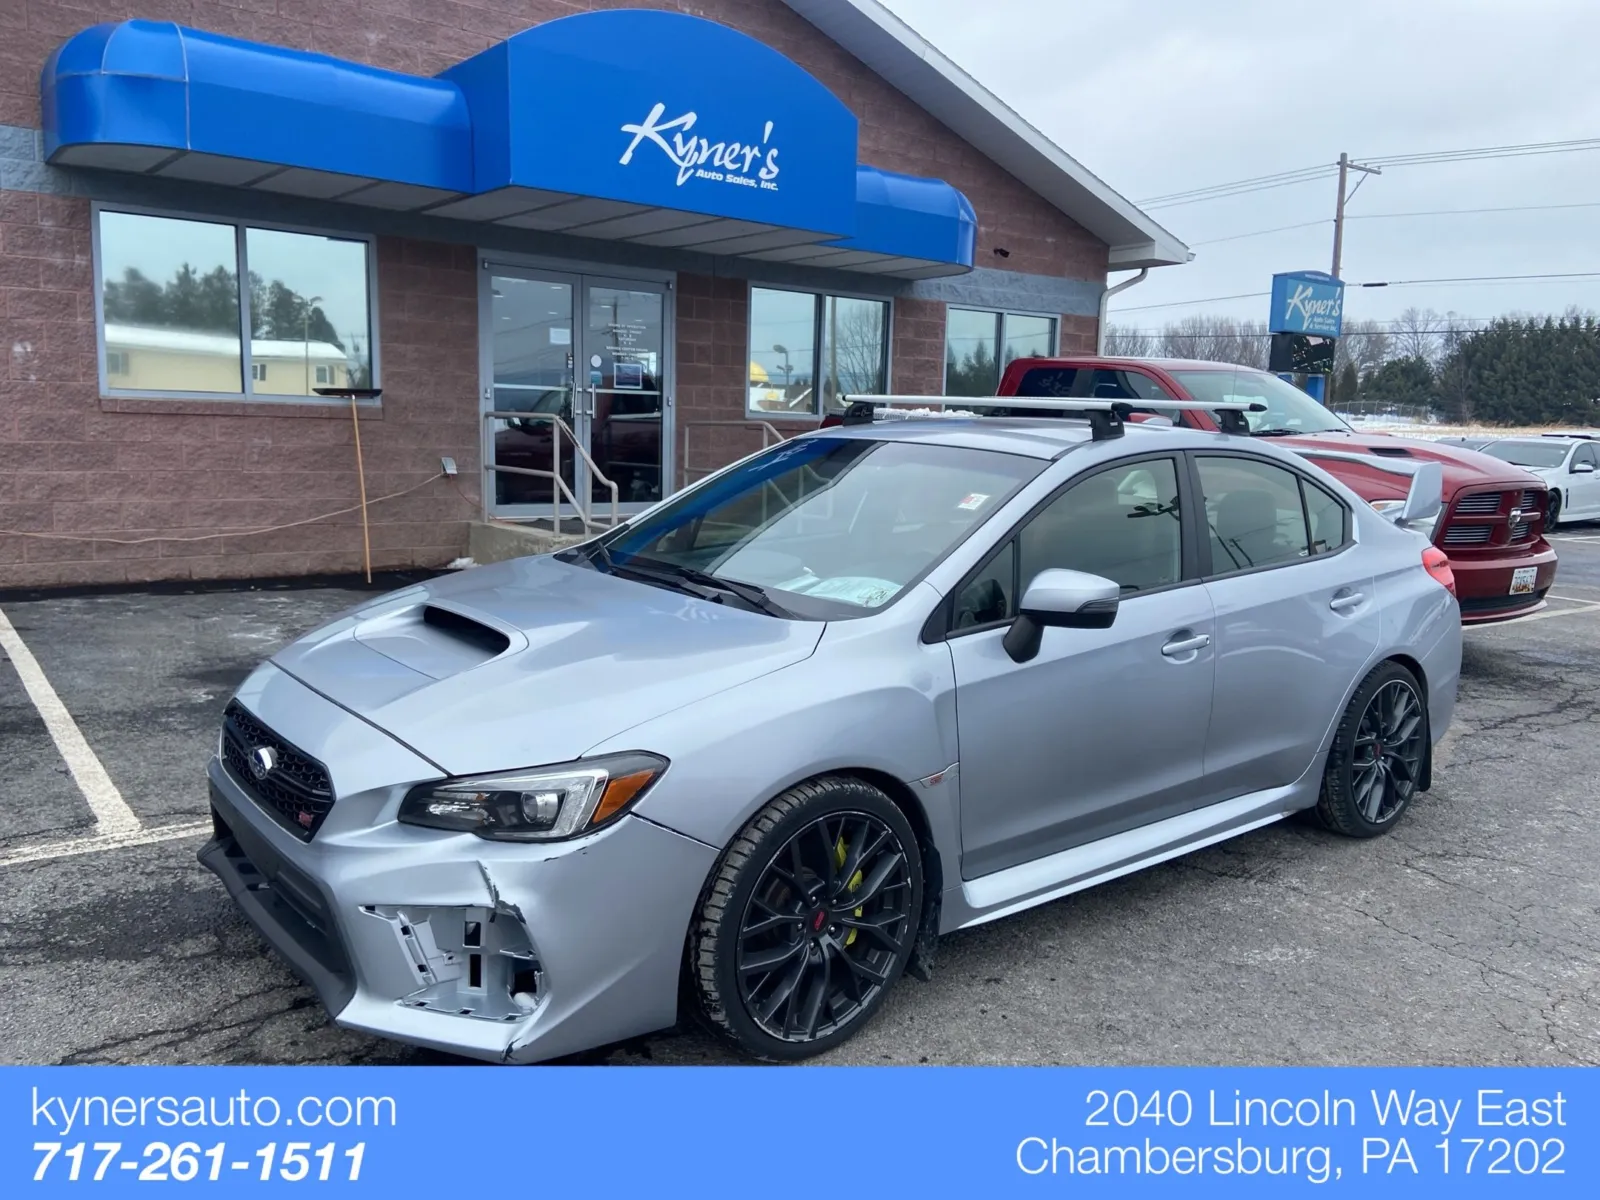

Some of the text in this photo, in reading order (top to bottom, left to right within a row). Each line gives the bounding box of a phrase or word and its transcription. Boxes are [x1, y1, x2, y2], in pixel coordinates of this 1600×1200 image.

[618, 102, 780, 186] Kyner's
[695, 168, 779, 191] Auto Sales, Inc.
[1285, 283, 1341, 331] Kyner's
